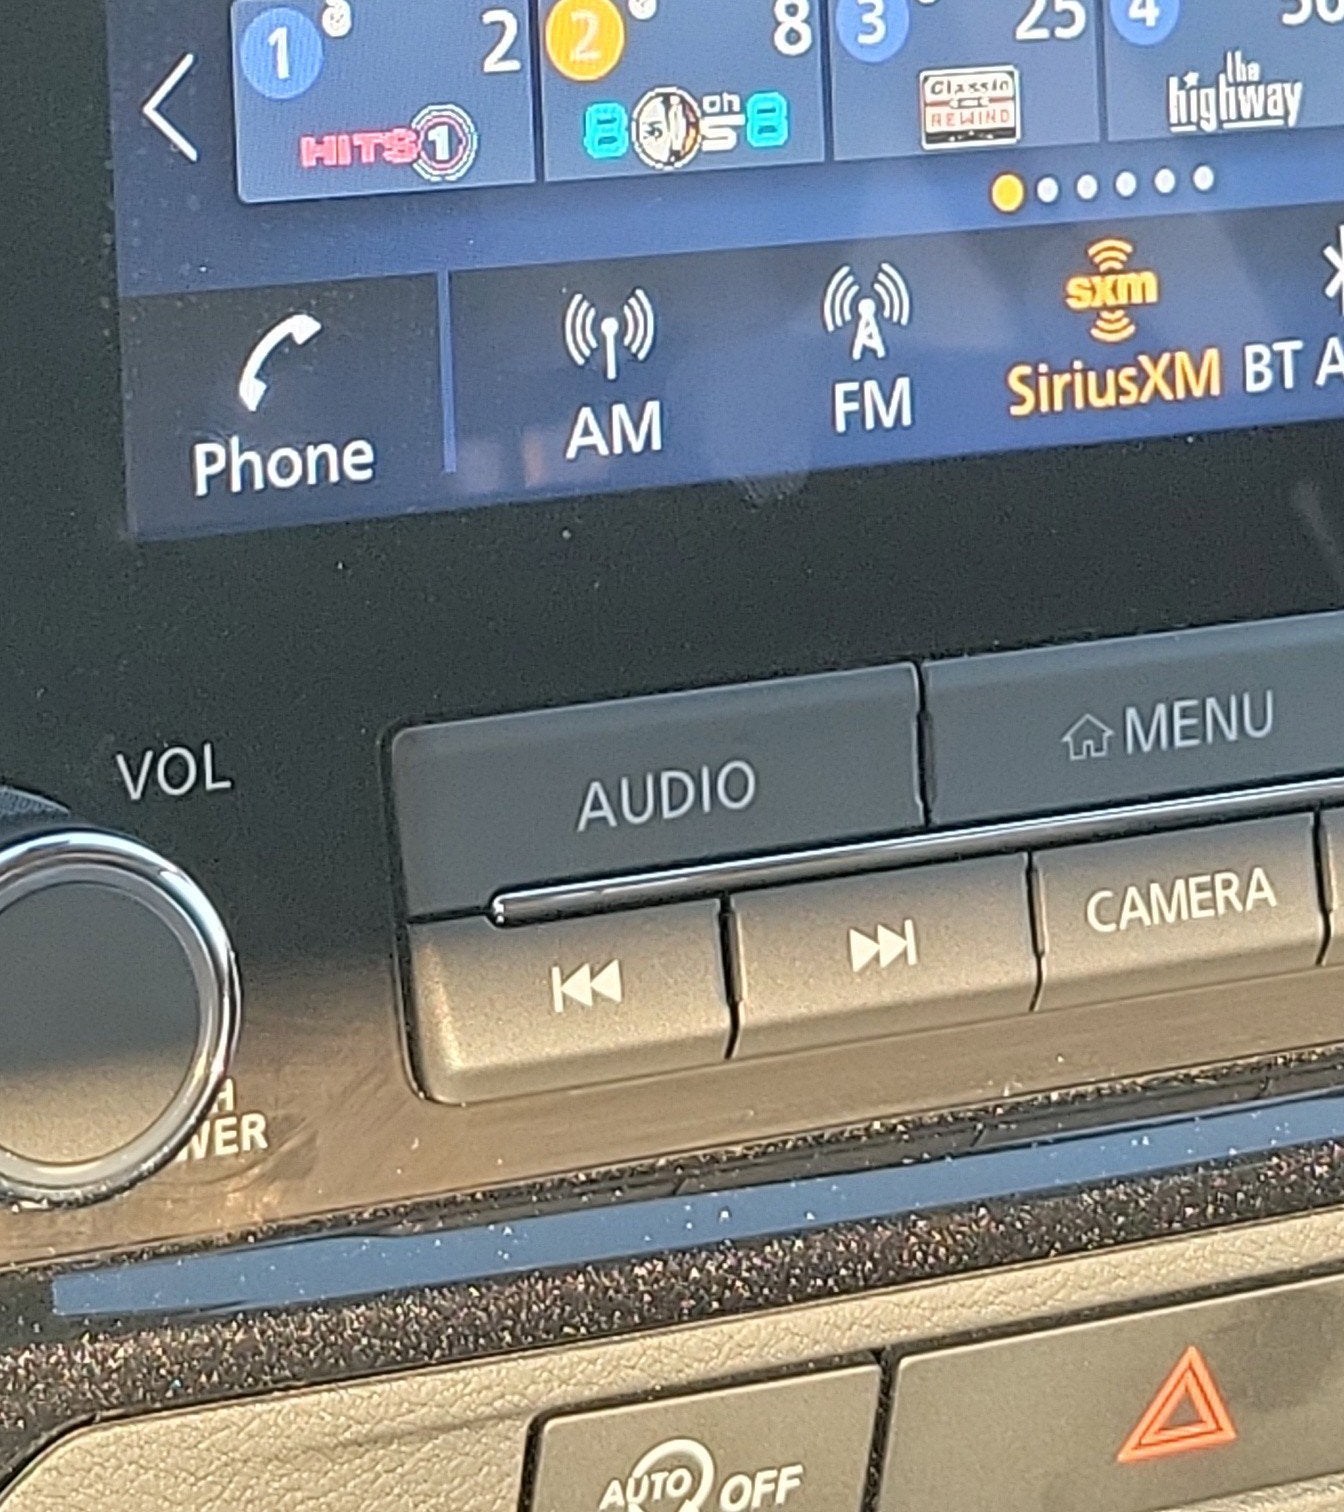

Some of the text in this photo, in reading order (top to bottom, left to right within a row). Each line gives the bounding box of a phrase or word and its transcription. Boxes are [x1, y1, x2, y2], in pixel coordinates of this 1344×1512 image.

[268, 27, 291, 80] 1
[481, 11, 522, 74] 2
[570, 11, 601, 62] 2
[1226, 51, 1258, 81] the
[1168, 72, 1302, 130] highway
[1065, 269, 1158, 311] sxm
[1007, 347, 1221, 416] SiriusXM
[1243, 339, 1304, 392] BT
[564, 399, 663, 460] AM
[834, 377, 912, 433] FM
[194, 436, 375, 497] Phone
[1125, 690, 1275, 755] MENU
[117, 743, 232, 801] VOL
[577, 760, 756, 832] AUDIO
[1086, 867, 1278, 933] CAMERA
[598, 1464, 804, 1511] AUTO OFF
